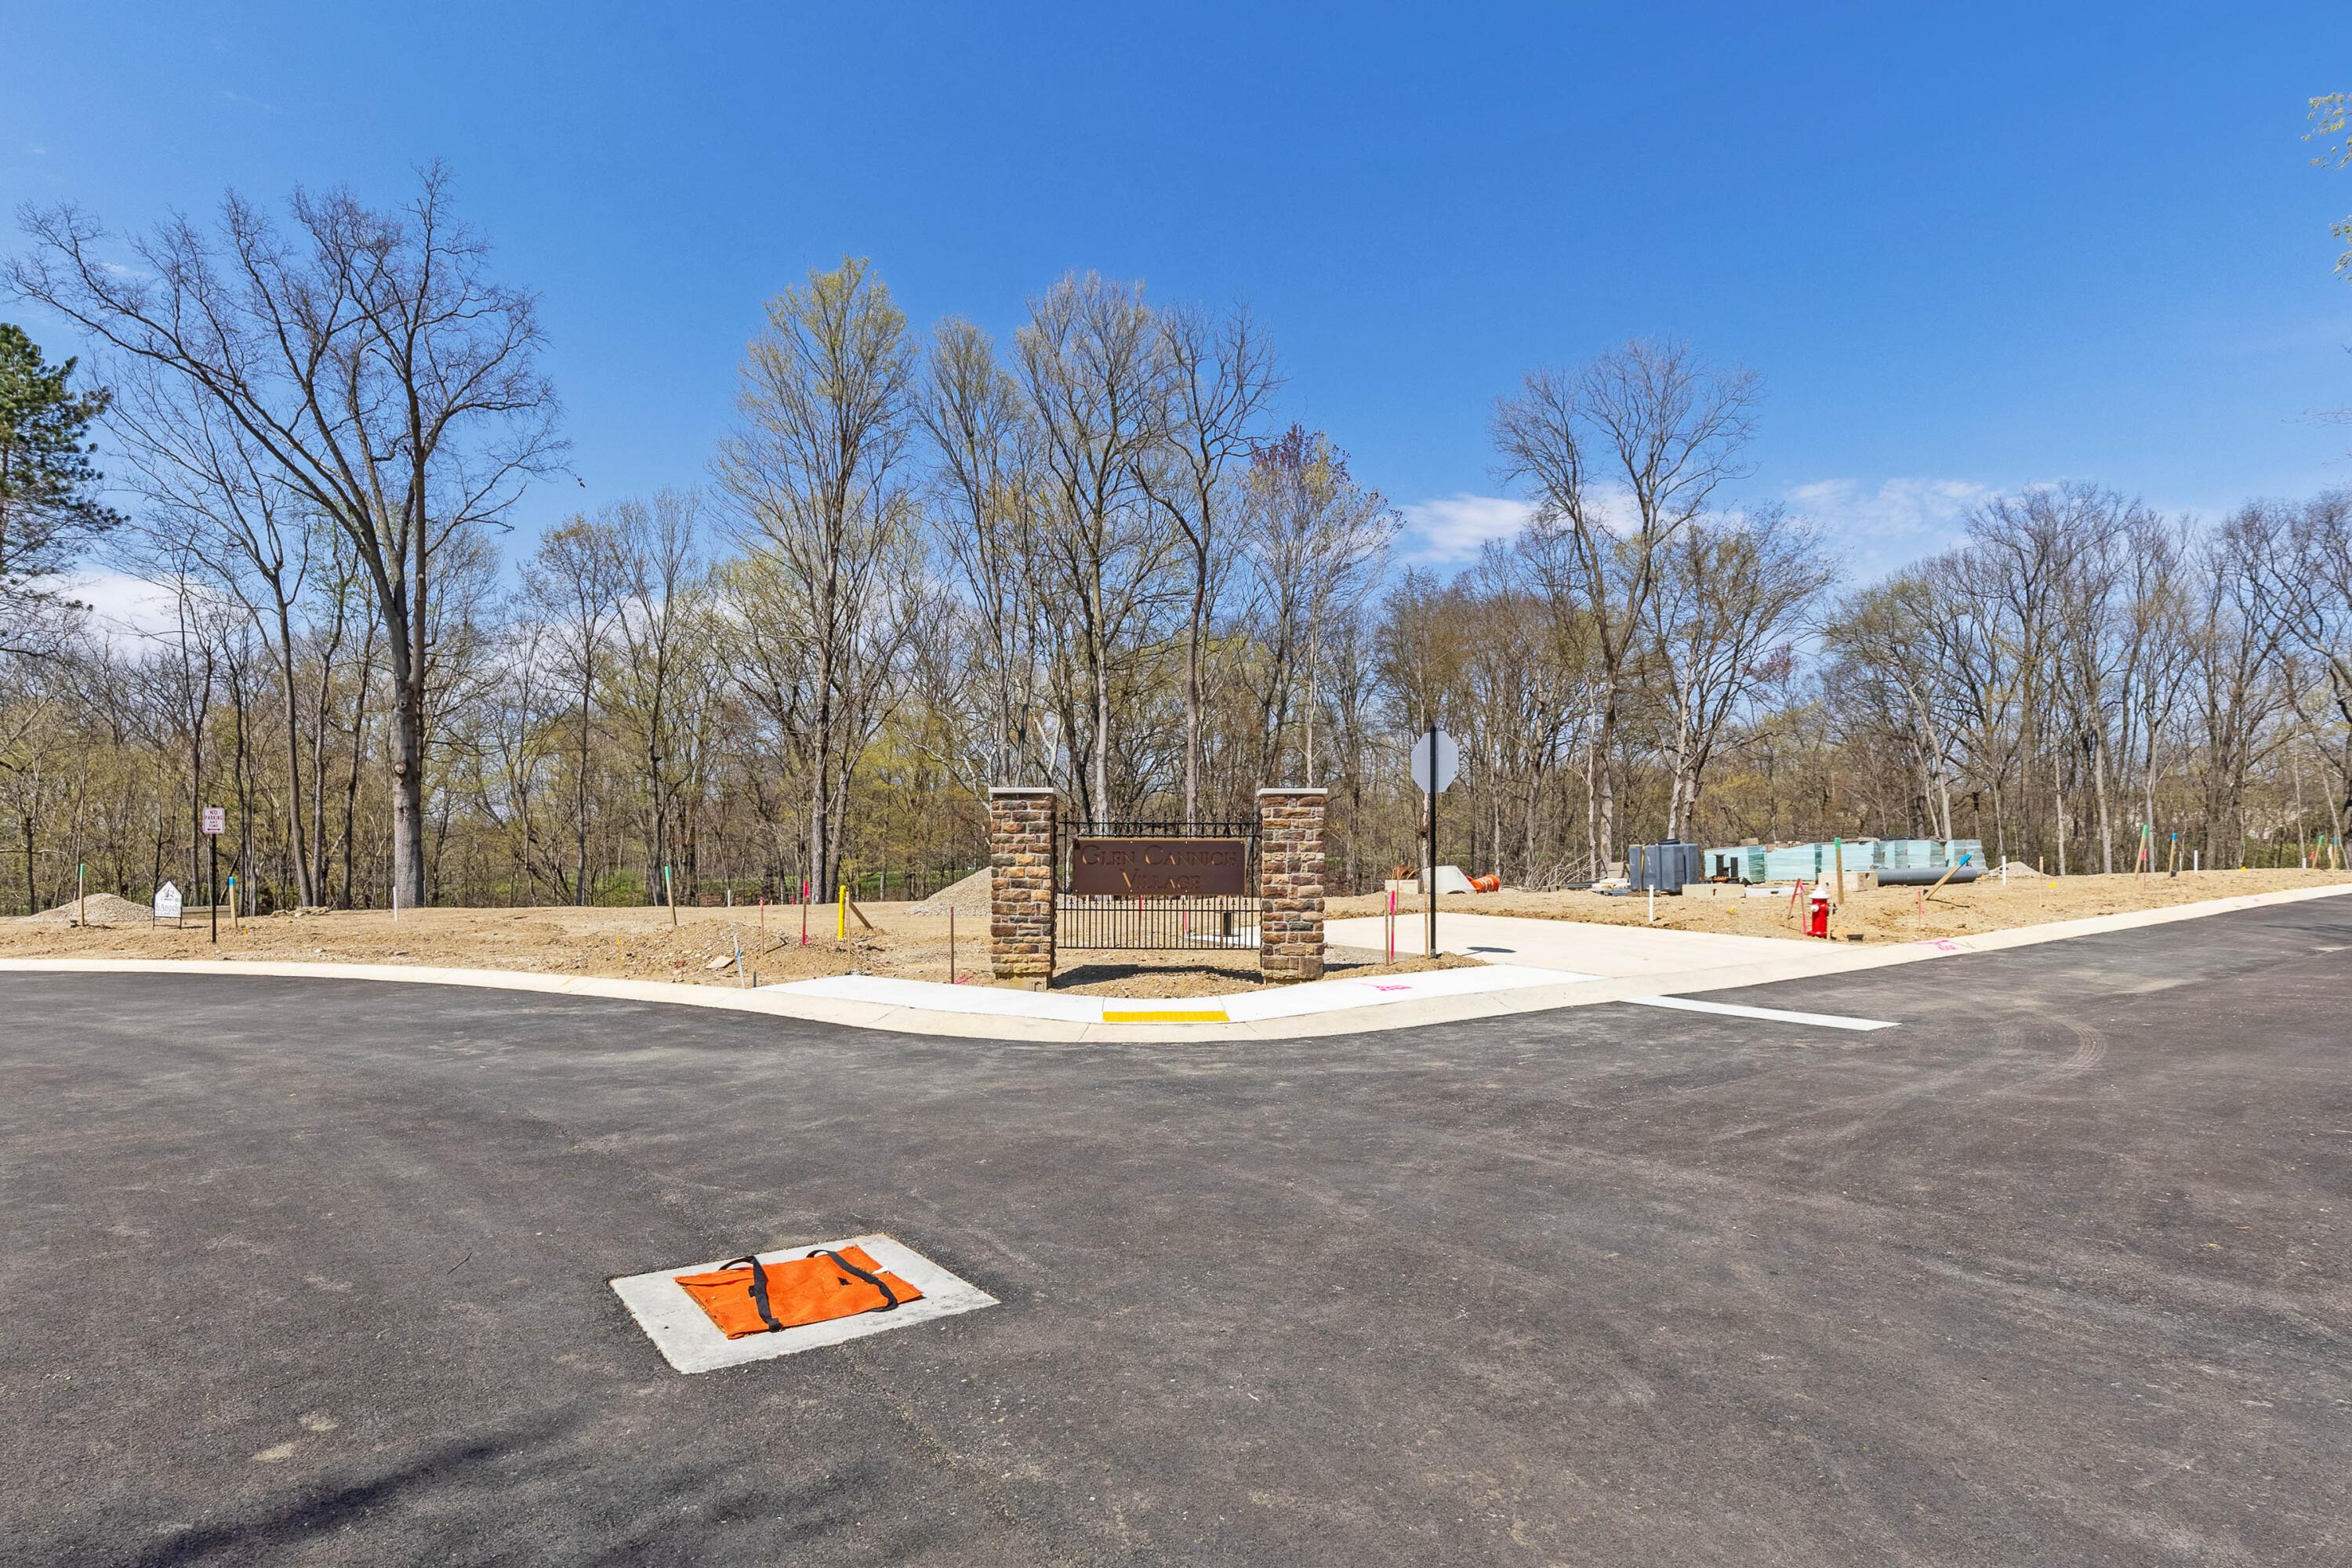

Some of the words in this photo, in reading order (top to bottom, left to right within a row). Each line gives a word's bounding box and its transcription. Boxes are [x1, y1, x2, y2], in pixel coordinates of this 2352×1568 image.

[1081, 844, 1135, 865] GLEN
[1145, 844, 1237, 866] CANNICH
[1120, 868, 1200, 889] VILLAGE
